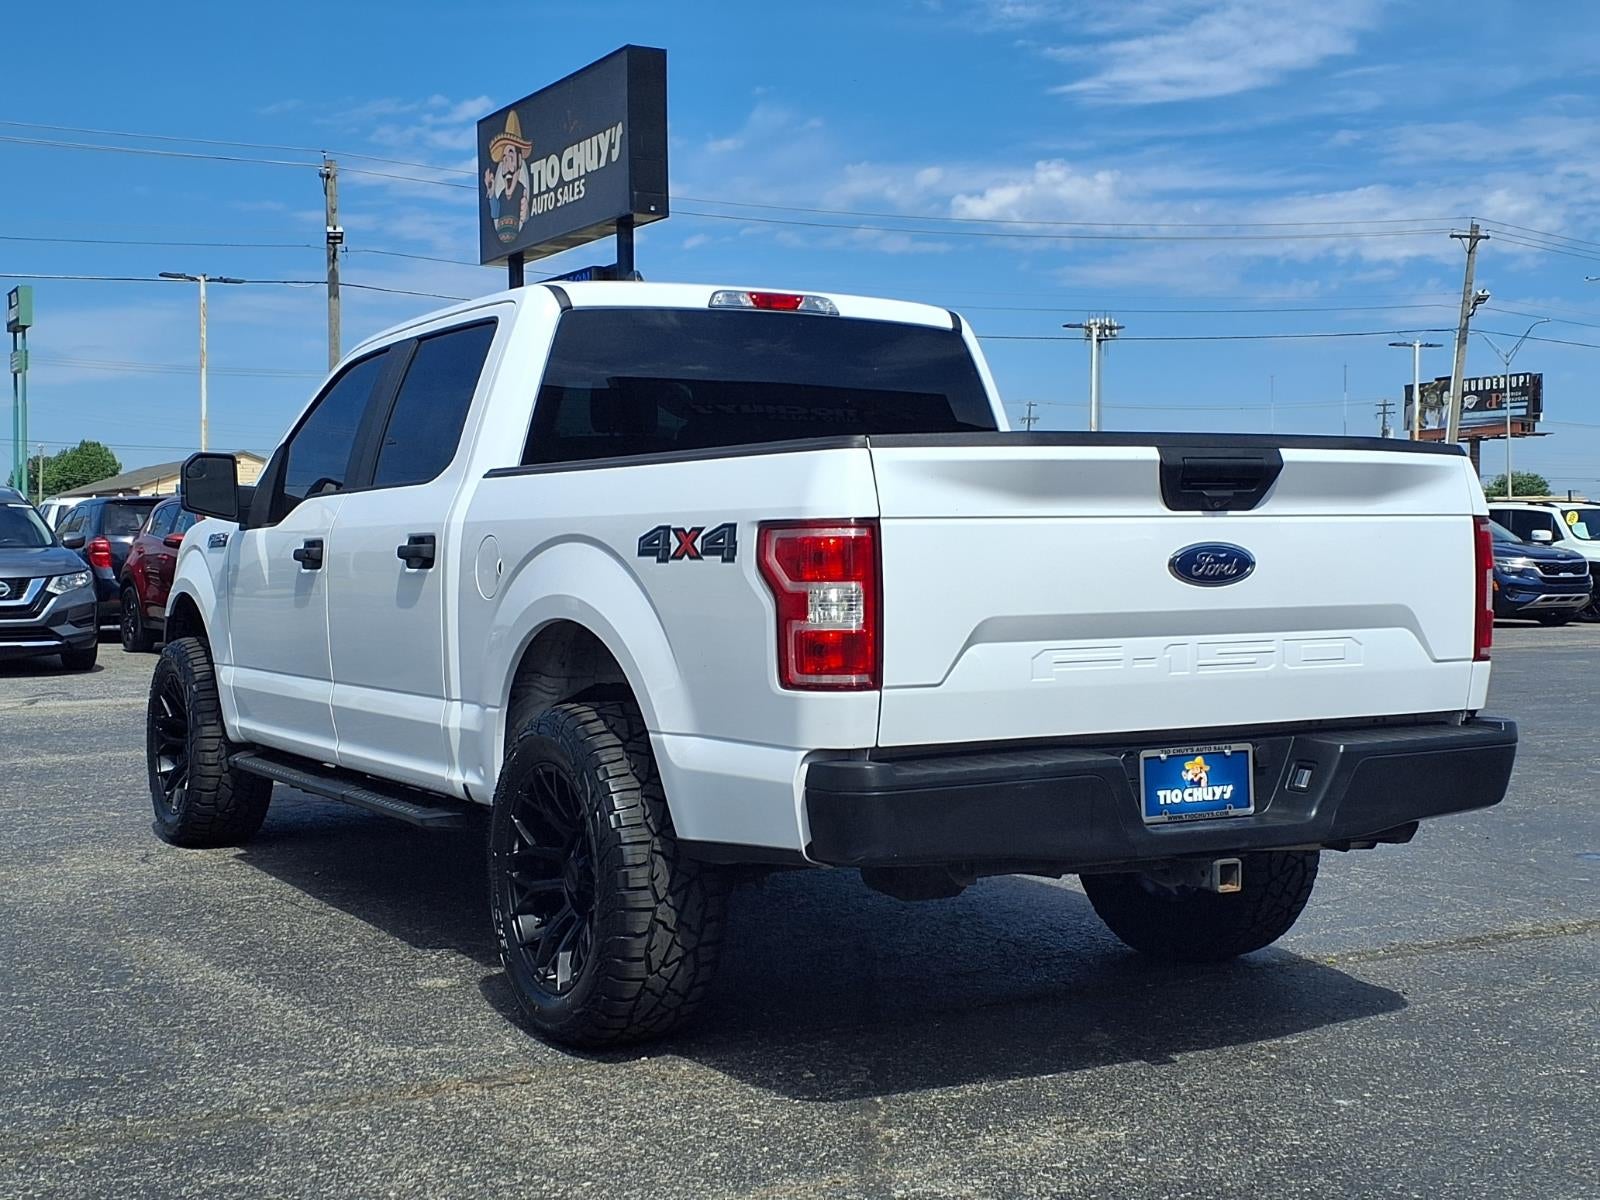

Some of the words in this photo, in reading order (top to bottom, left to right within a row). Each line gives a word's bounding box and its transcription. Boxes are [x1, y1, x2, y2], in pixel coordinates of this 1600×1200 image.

[530, 152, 560, 195] TIO
[561, 121, 623, 183] CHUY'S
[530, 192, 555, 217] AUTO
[556, 179, 586, 208] SALES
[1463, 377, 1505, 392] HUNDER
[1511, 374, 1530, 388] UP!
[1191, 551, 1239, 577] Ford
[1031, 636, 1364, 682] F-150
[1157, 789, 1183, 805] TIO
[1183, 784, 1234, 803] CHUY'S
